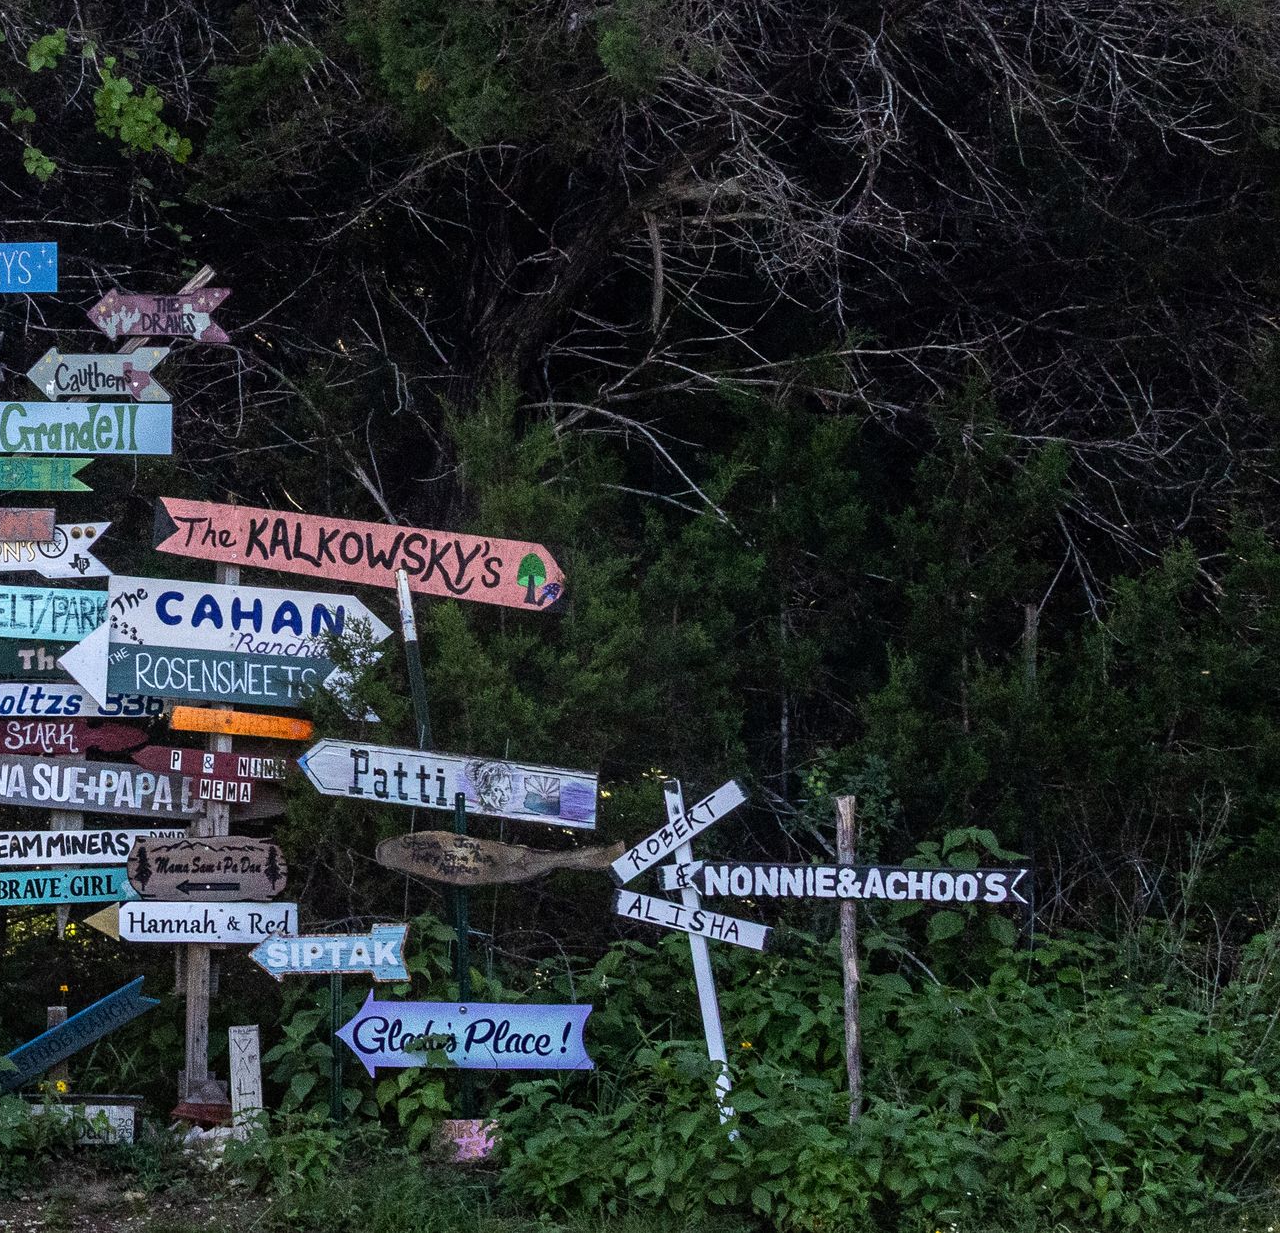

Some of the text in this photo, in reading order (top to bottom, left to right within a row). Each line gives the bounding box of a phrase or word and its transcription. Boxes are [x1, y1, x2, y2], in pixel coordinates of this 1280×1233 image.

[0, 404, 140, 452] Grandell
[155, 590, 344, 637] CAHAN
[108, 647, 129, 665] THE
[349, 748, 447, 801] Patti
[200, 779, 250, 802] MEMA
[47, 832, 130, 858] MINERS
[627, 795, 717, 871] ROBERT
[71, 875, 118, 896] GIRL
[128, 911, 217, 935] Hannah
[627, 898, 740, 942] ALISHA
[266, 939, 399, 968] SIPTAK
